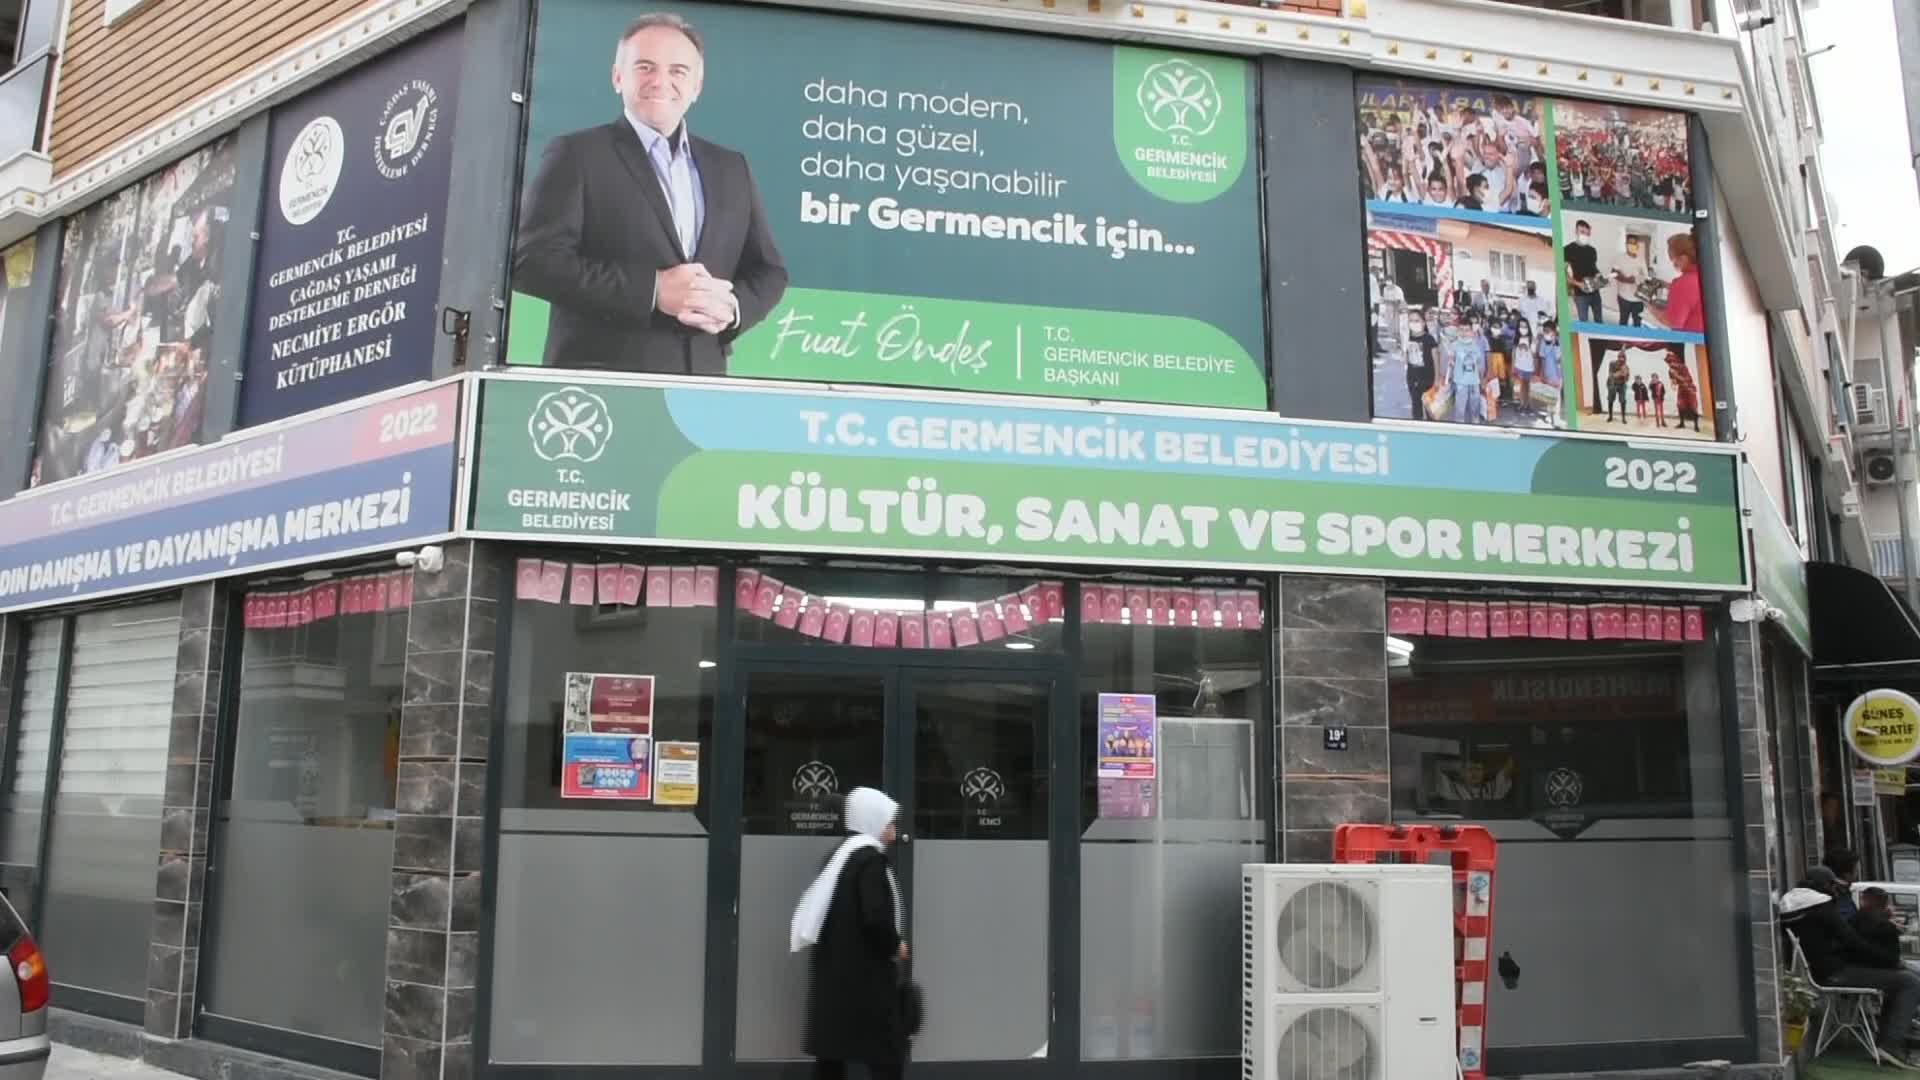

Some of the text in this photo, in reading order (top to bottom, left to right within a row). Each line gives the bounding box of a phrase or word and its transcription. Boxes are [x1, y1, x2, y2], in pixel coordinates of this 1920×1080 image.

[804, 78, 1029, 125] daha modern,
[802, 115, 985, 157] daha güzel,
[1135, 147, 1227, 169] GERMENCİK
[801, 152, 1067, 199] daha yaşanabilir
[1146, 166, 1217, 184] BELEDİYESİ
[337, 225, 357, 244] T.C.
[801, 192, 1195, 260] bir Germencik için...
[269, 213, 428, 288] GERMENCİK BELEDİYESİ
[268, 264, 417, 332] DESTEKLEME DERNEĞİ
[290, 254, 397, 307] ÇAĞDAŞ YAŞAMI
[271, 300, 407, 361] NECMİYE ERGÖR
[770, 305, 993, 375] Fuat Öndeş
[1043, 326, 1074, 342] T.C.
[276, 334, 393, 390] KÜTÜPHANESİ
[1044, 346, 1236, 374] GERMENCİK BELEDİYE
[1044, 367, 1120, 386] BAŞKANI
[380, 404, 439, 443] 2022
[800, 410, 1390, 476] T.C. GERMENCİK BELEDİYESİ
[50, 434, 284, 527] T.C. GERMENCİK BELEDİYESİ
[556, 469, 585, 484] T.C.
[1604, 456, 1697, 493] 2022
[507, 488, 630, 512] GERMENCİK
[522, 510, 615, 531] BELEDİYESİ
[737, 471, 1694, 573] KÜLTÜR, SANAT VE SPOR MERKEZİ
[29, 548, 111, 593] DANIŞMA
[116, 542, 144, 575] VE
[144, 514, 279, 565] DAYANIŞMA
[283, 471, 412, 544] MERKEZİ
